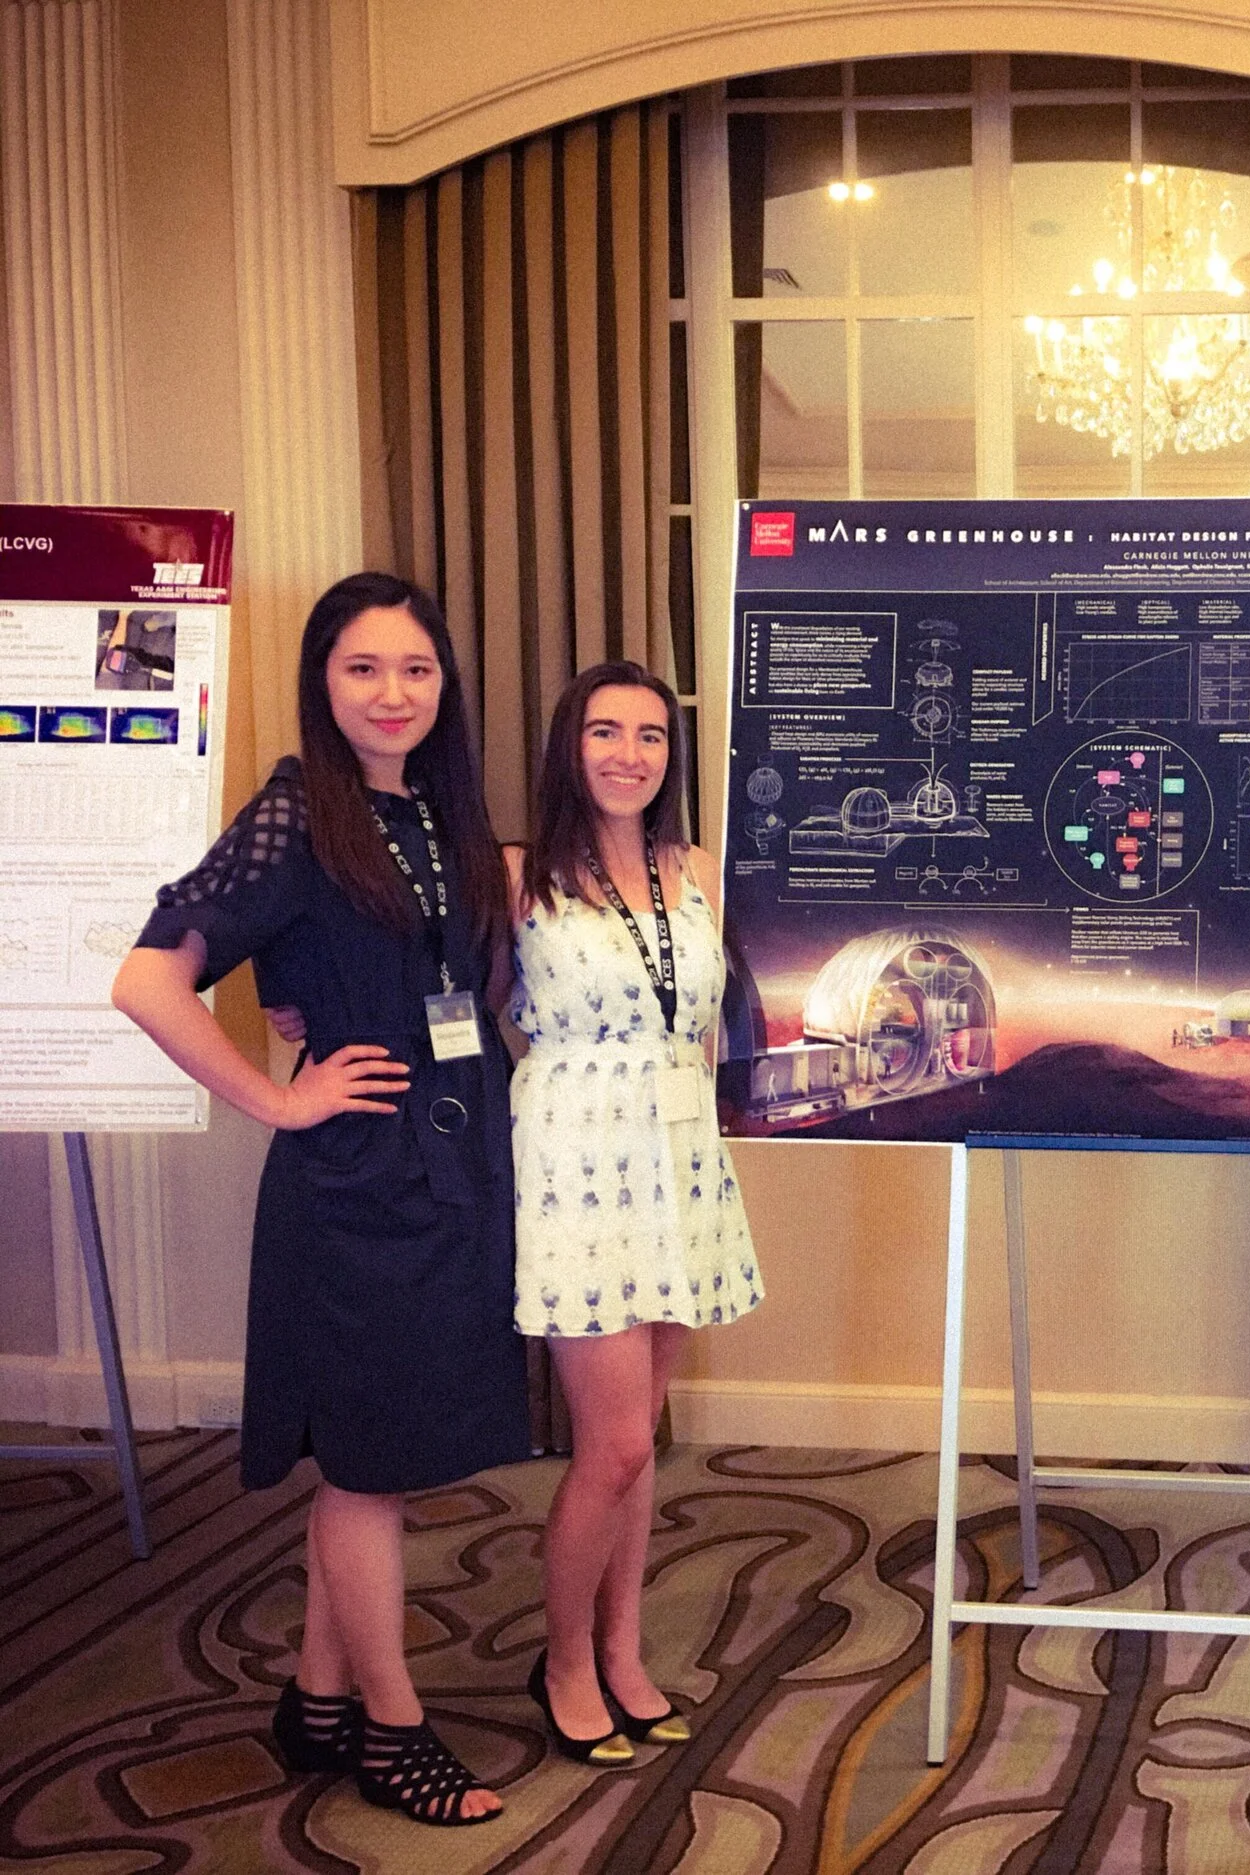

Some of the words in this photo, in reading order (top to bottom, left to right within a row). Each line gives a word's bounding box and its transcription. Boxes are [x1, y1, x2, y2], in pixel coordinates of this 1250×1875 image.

[907, 529, 1075, 543] GREENHOUSE
[1111, 532, 1176, 542] HABITAT
[1182, 532, 1238, 541] DESIGN
[0, 537, 54, 553] (LCVG)
[1123, 552, 1178, 560] CARNEGIE
[1183, 552, 1227, 560] MELLON
[749, 622, 759, 695] ABSTRACT
